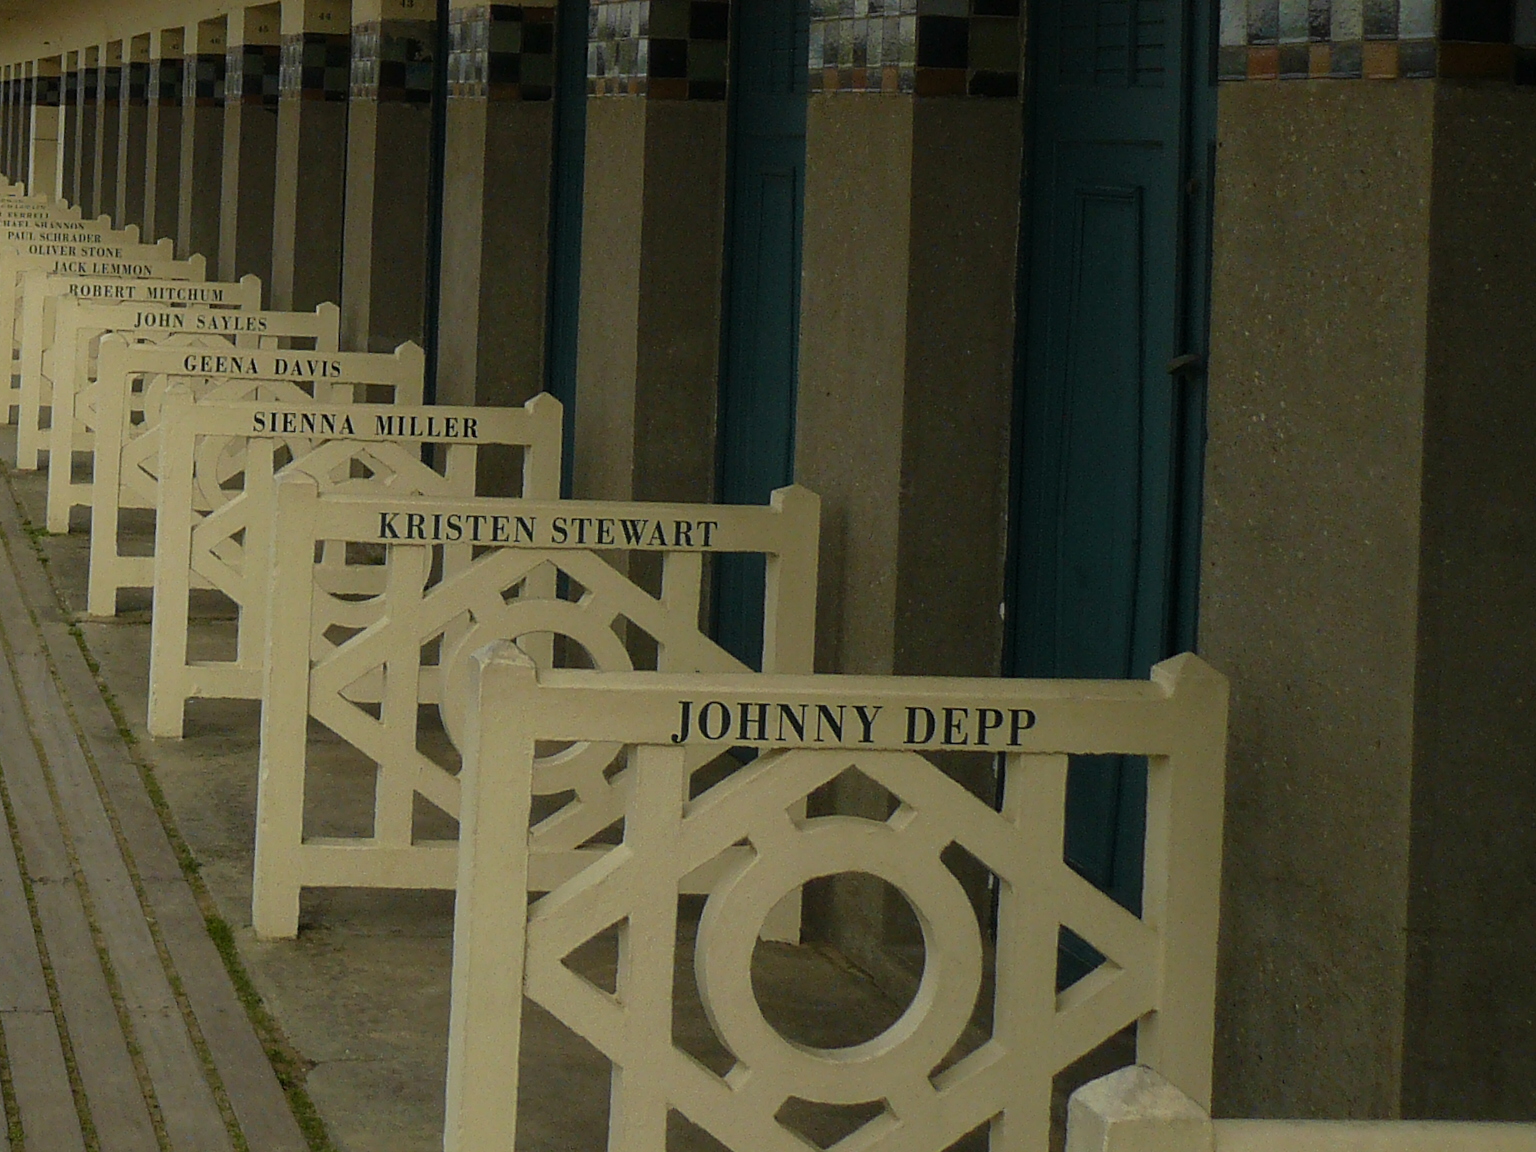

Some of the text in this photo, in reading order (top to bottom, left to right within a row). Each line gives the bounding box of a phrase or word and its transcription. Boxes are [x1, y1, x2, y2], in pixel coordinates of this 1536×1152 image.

[34, 221, 86, 230] SHANNON
[7, 231, 102, 243] PAUL SCHRADER
[29, 244, 123, 259] OLIVER STONE
[52, 260, 153, 276] JACK LEMMON
[69, 283, 224, 302] ROBERT MITCHUM
[134, 311, 269, 332] JOHN SAYLES
[184, 354, 342, 378] GEENA DAVIS
[252, 410, 479, 440] SIENNA MILLER
[378, 511, 719, 548] KRISTEN STEWART
[670, 699, 1038, 747] JOHNNY DEPP
